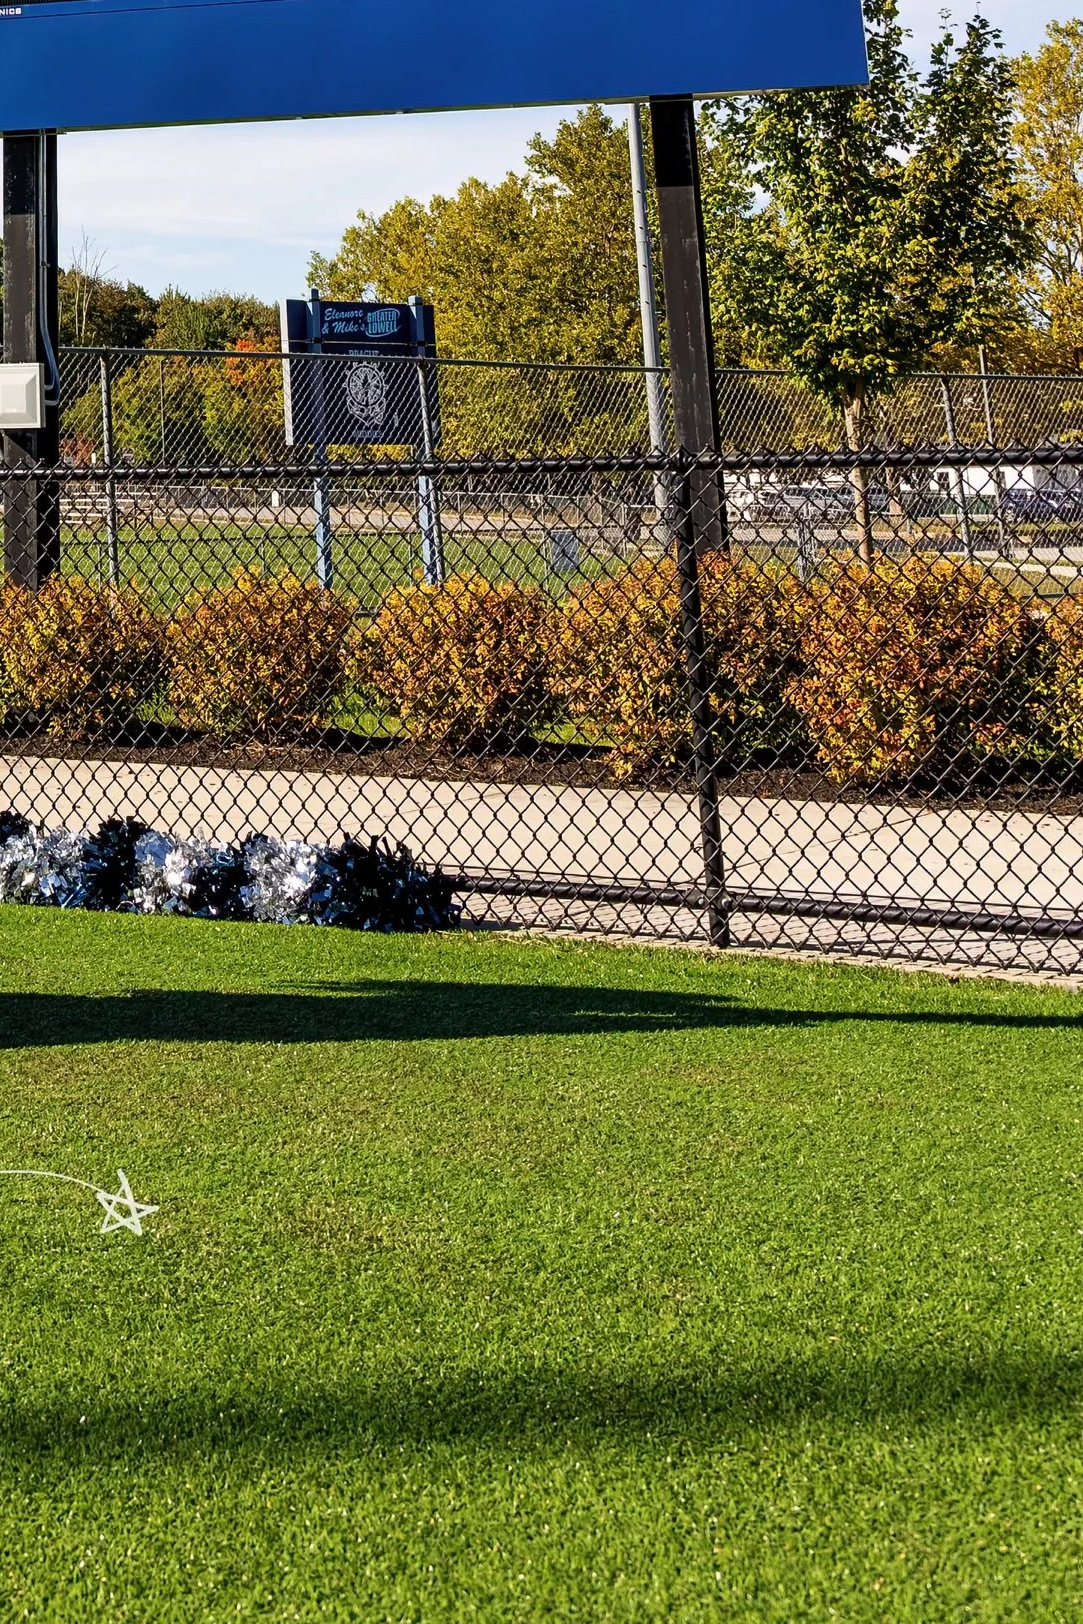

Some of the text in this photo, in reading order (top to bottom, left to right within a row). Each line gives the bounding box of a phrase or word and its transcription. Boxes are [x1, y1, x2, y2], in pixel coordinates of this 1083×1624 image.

[367, 311, 397, 322] GREATER
[321, 319, 365, 334] & Mike's
[368, 321, 398, 333] LOWELL
